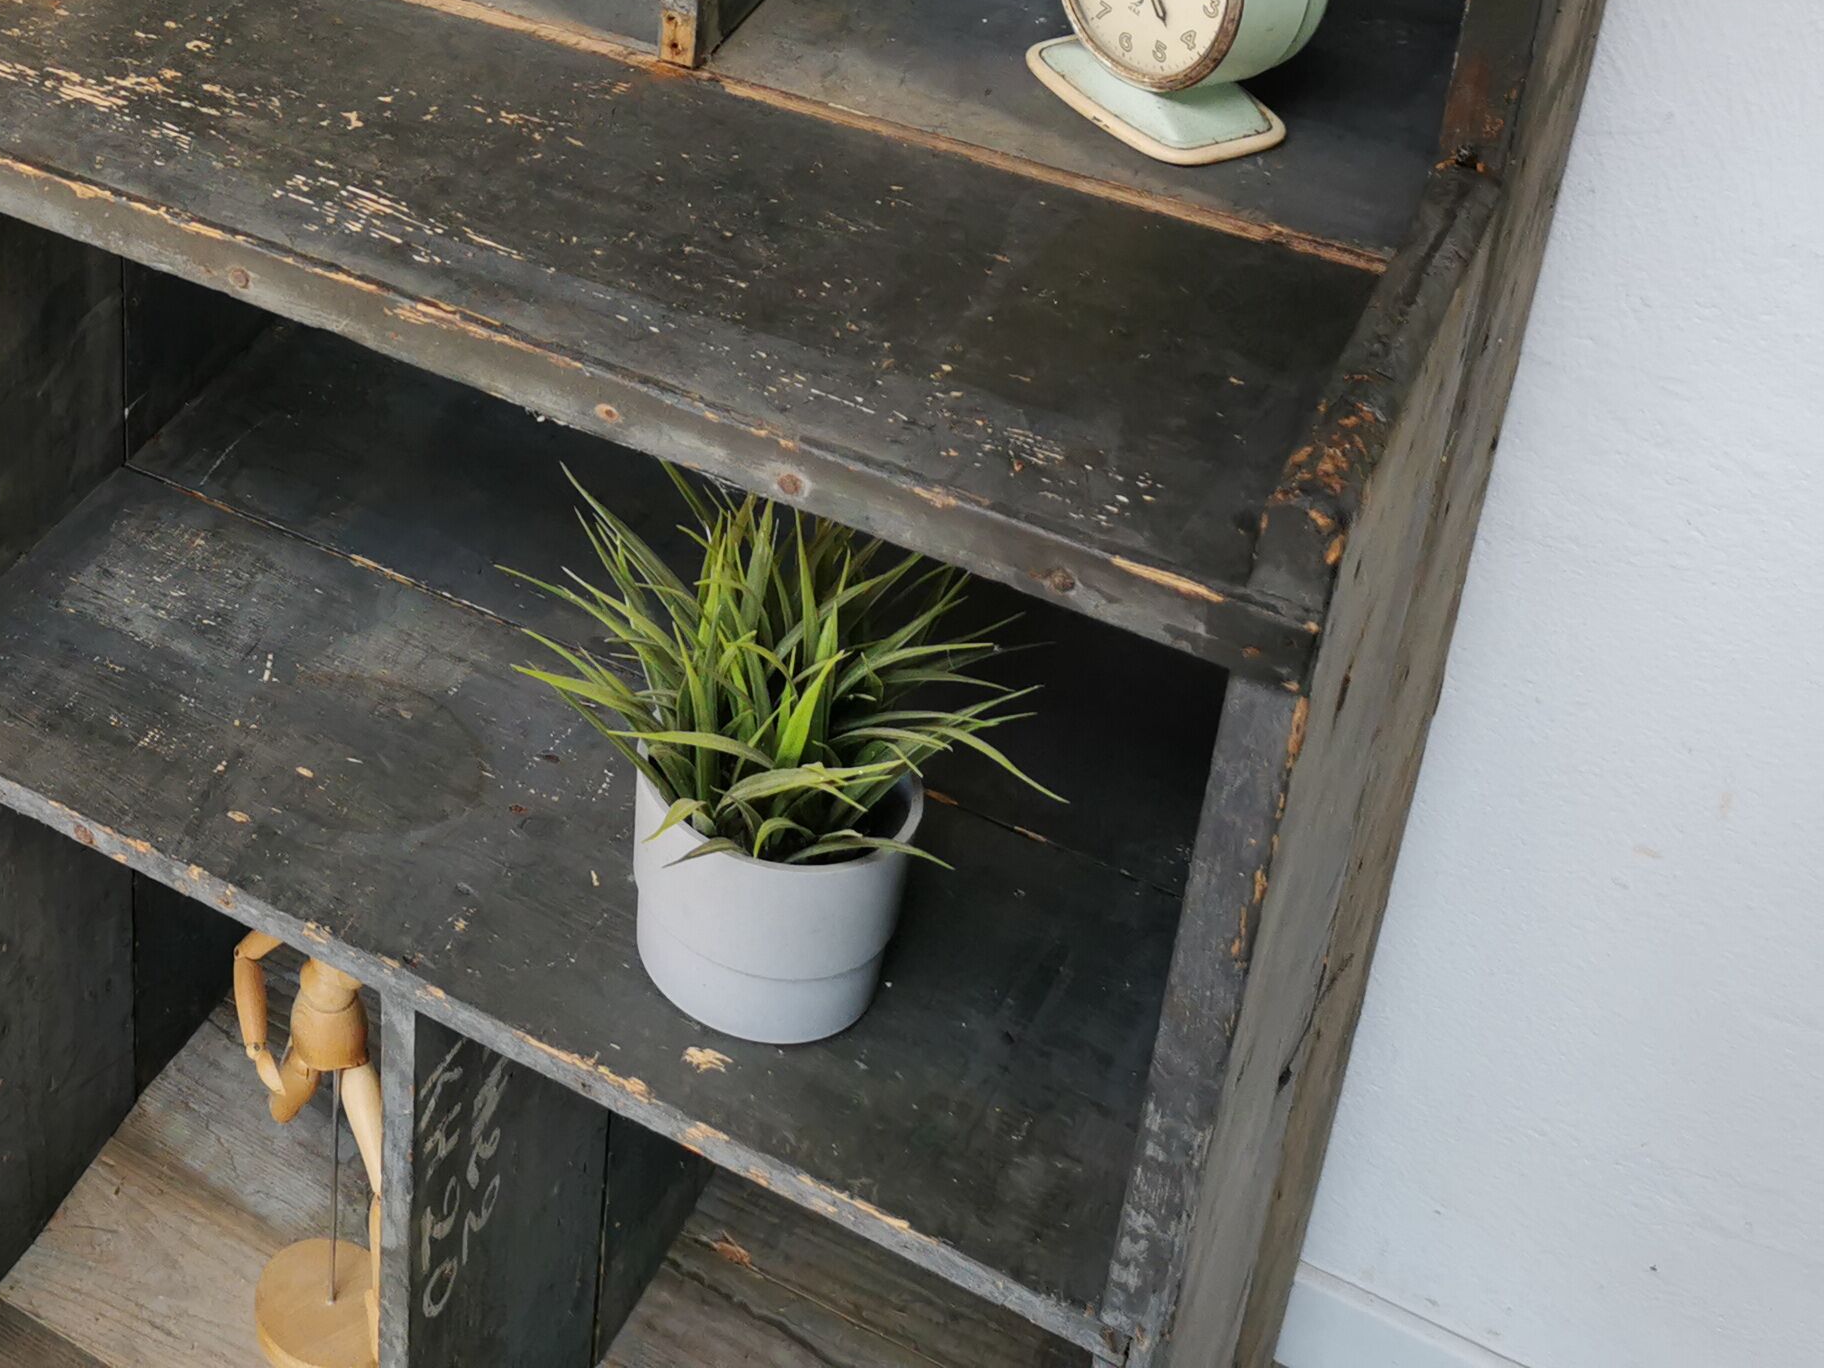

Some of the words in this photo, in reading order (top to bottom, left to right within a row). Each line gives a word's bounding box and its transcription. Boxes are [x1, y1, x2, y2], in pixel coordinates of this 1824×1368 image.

[1095, 0, 1112, 19] 7
[1118, 32, 1133, 54] 6
[1180, 30, 1197, 51] 4
[1152, 40, 1167, 63] 5
